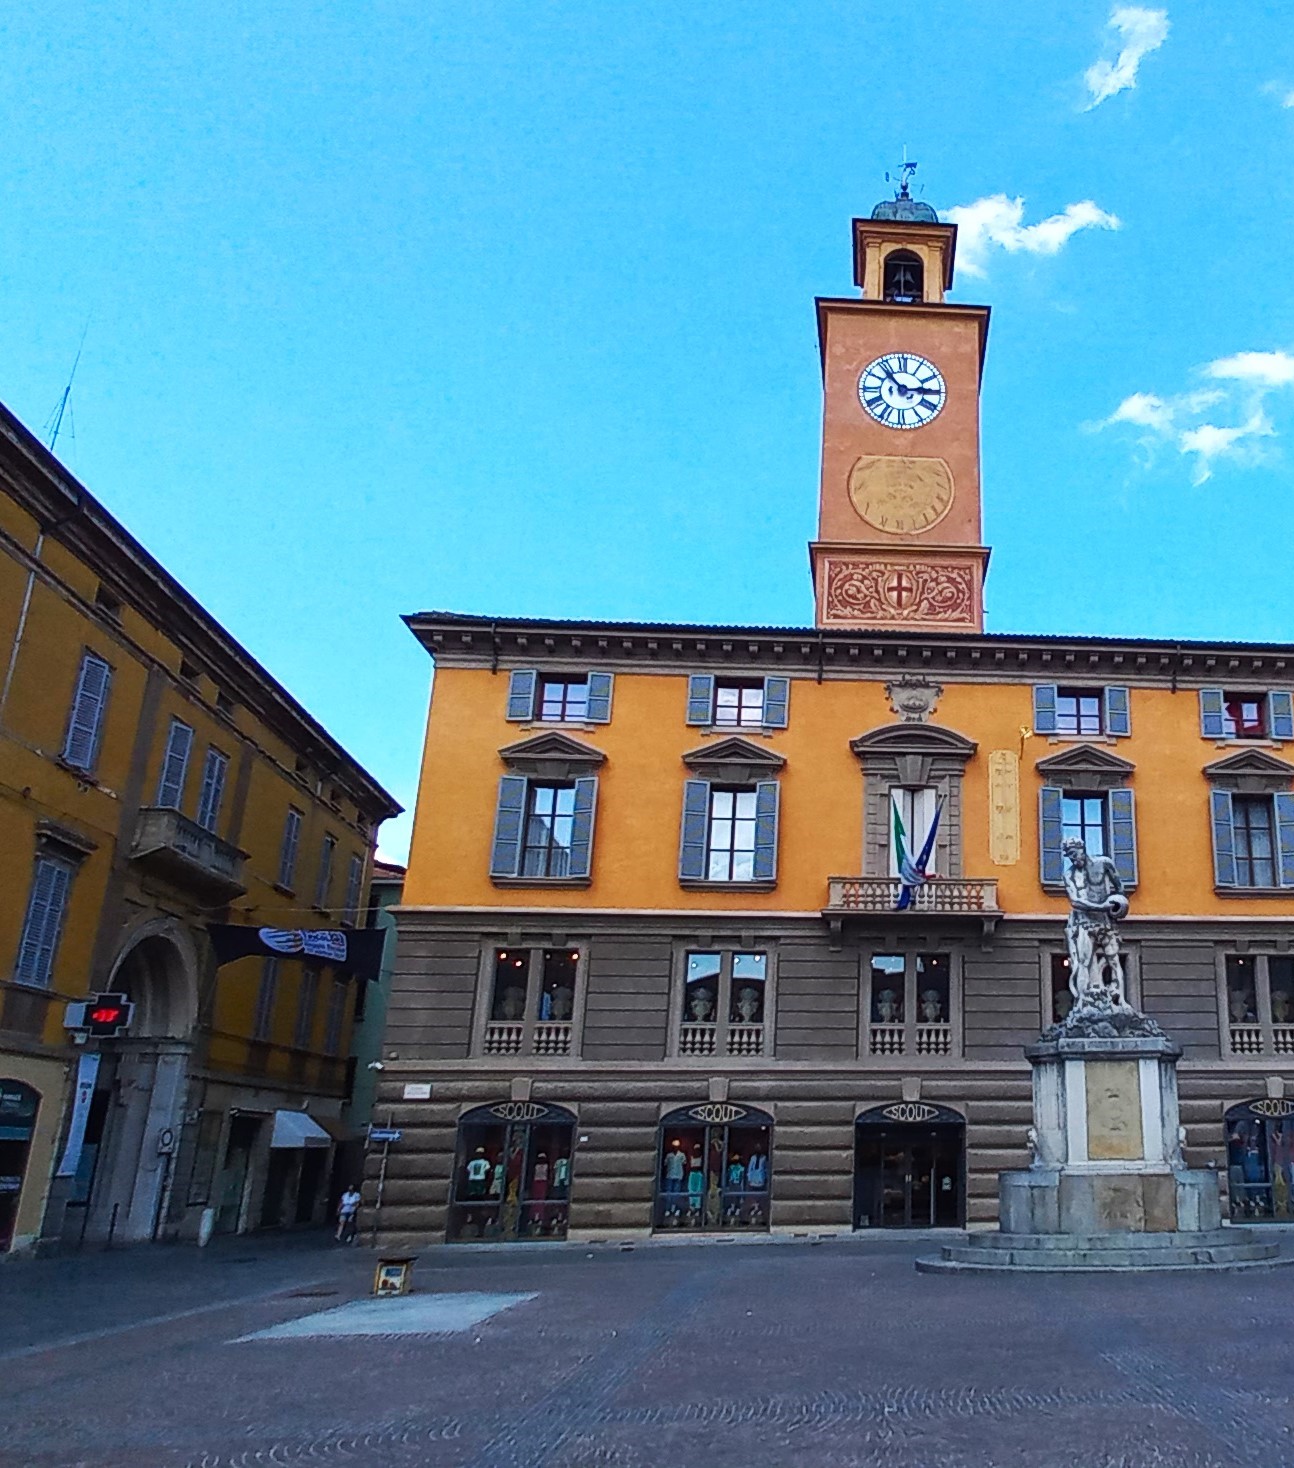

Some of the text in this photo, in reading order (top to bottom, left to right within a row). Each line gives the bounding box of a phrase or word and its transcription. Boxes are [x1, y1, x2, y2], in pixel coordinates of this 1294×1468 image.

[498, 1102, 539, 1120] SCOUT
[697, 1104, 737, 1122] SCOUT
[891, 1103, 930, 1121] SCOUT
[1257, 1099, 1294, 1116] SCOUT
